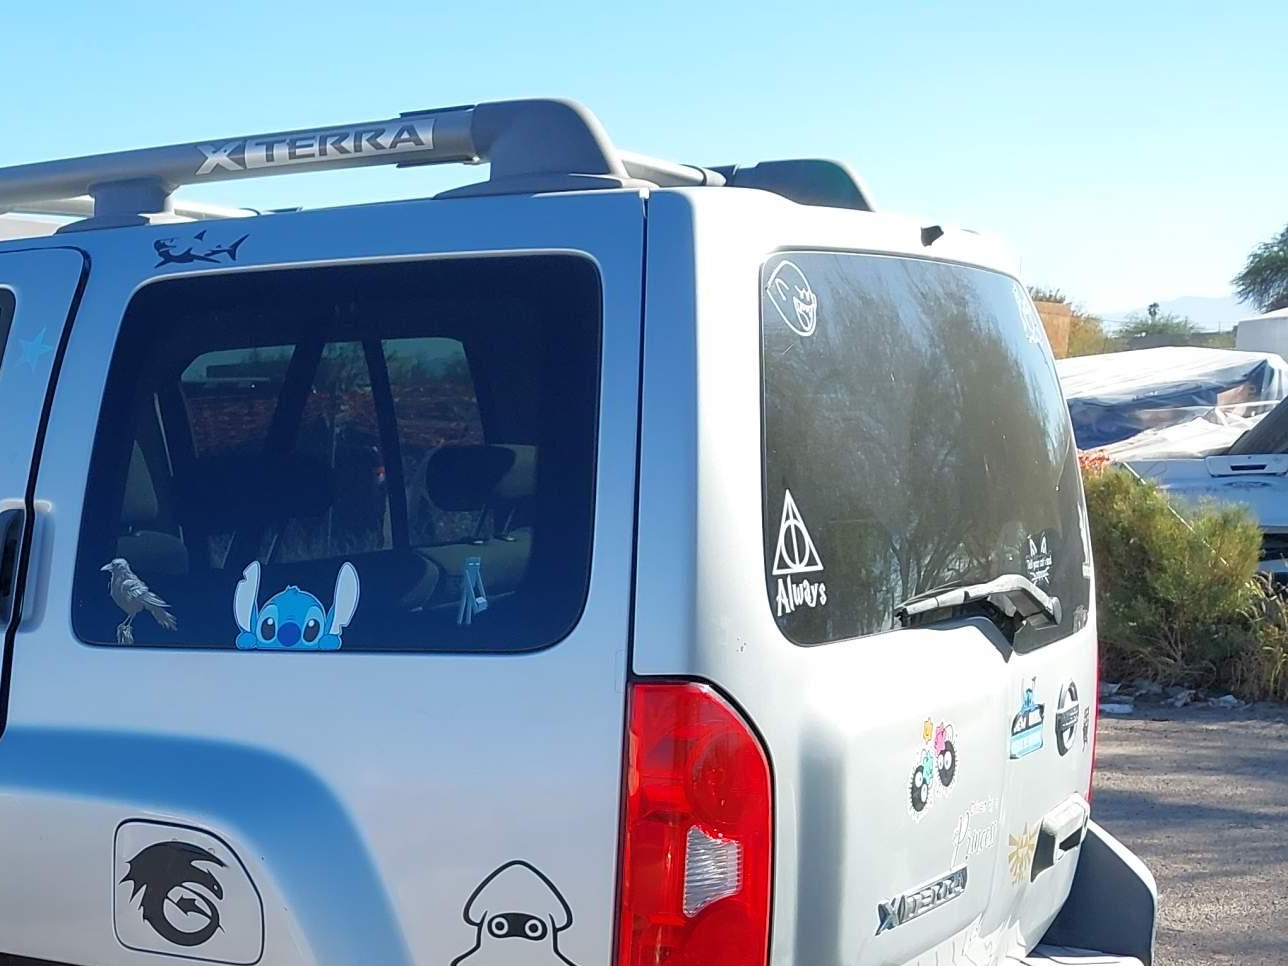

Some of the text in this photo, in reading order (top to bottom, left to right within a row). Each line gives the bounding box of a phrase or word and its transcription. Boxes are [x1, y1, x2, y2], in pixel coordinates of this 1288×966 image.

[195, 122, 426, 176] XTERRA
[775, 574, 828, 617] Always
[874, 866, 969, 937] XTERRA
